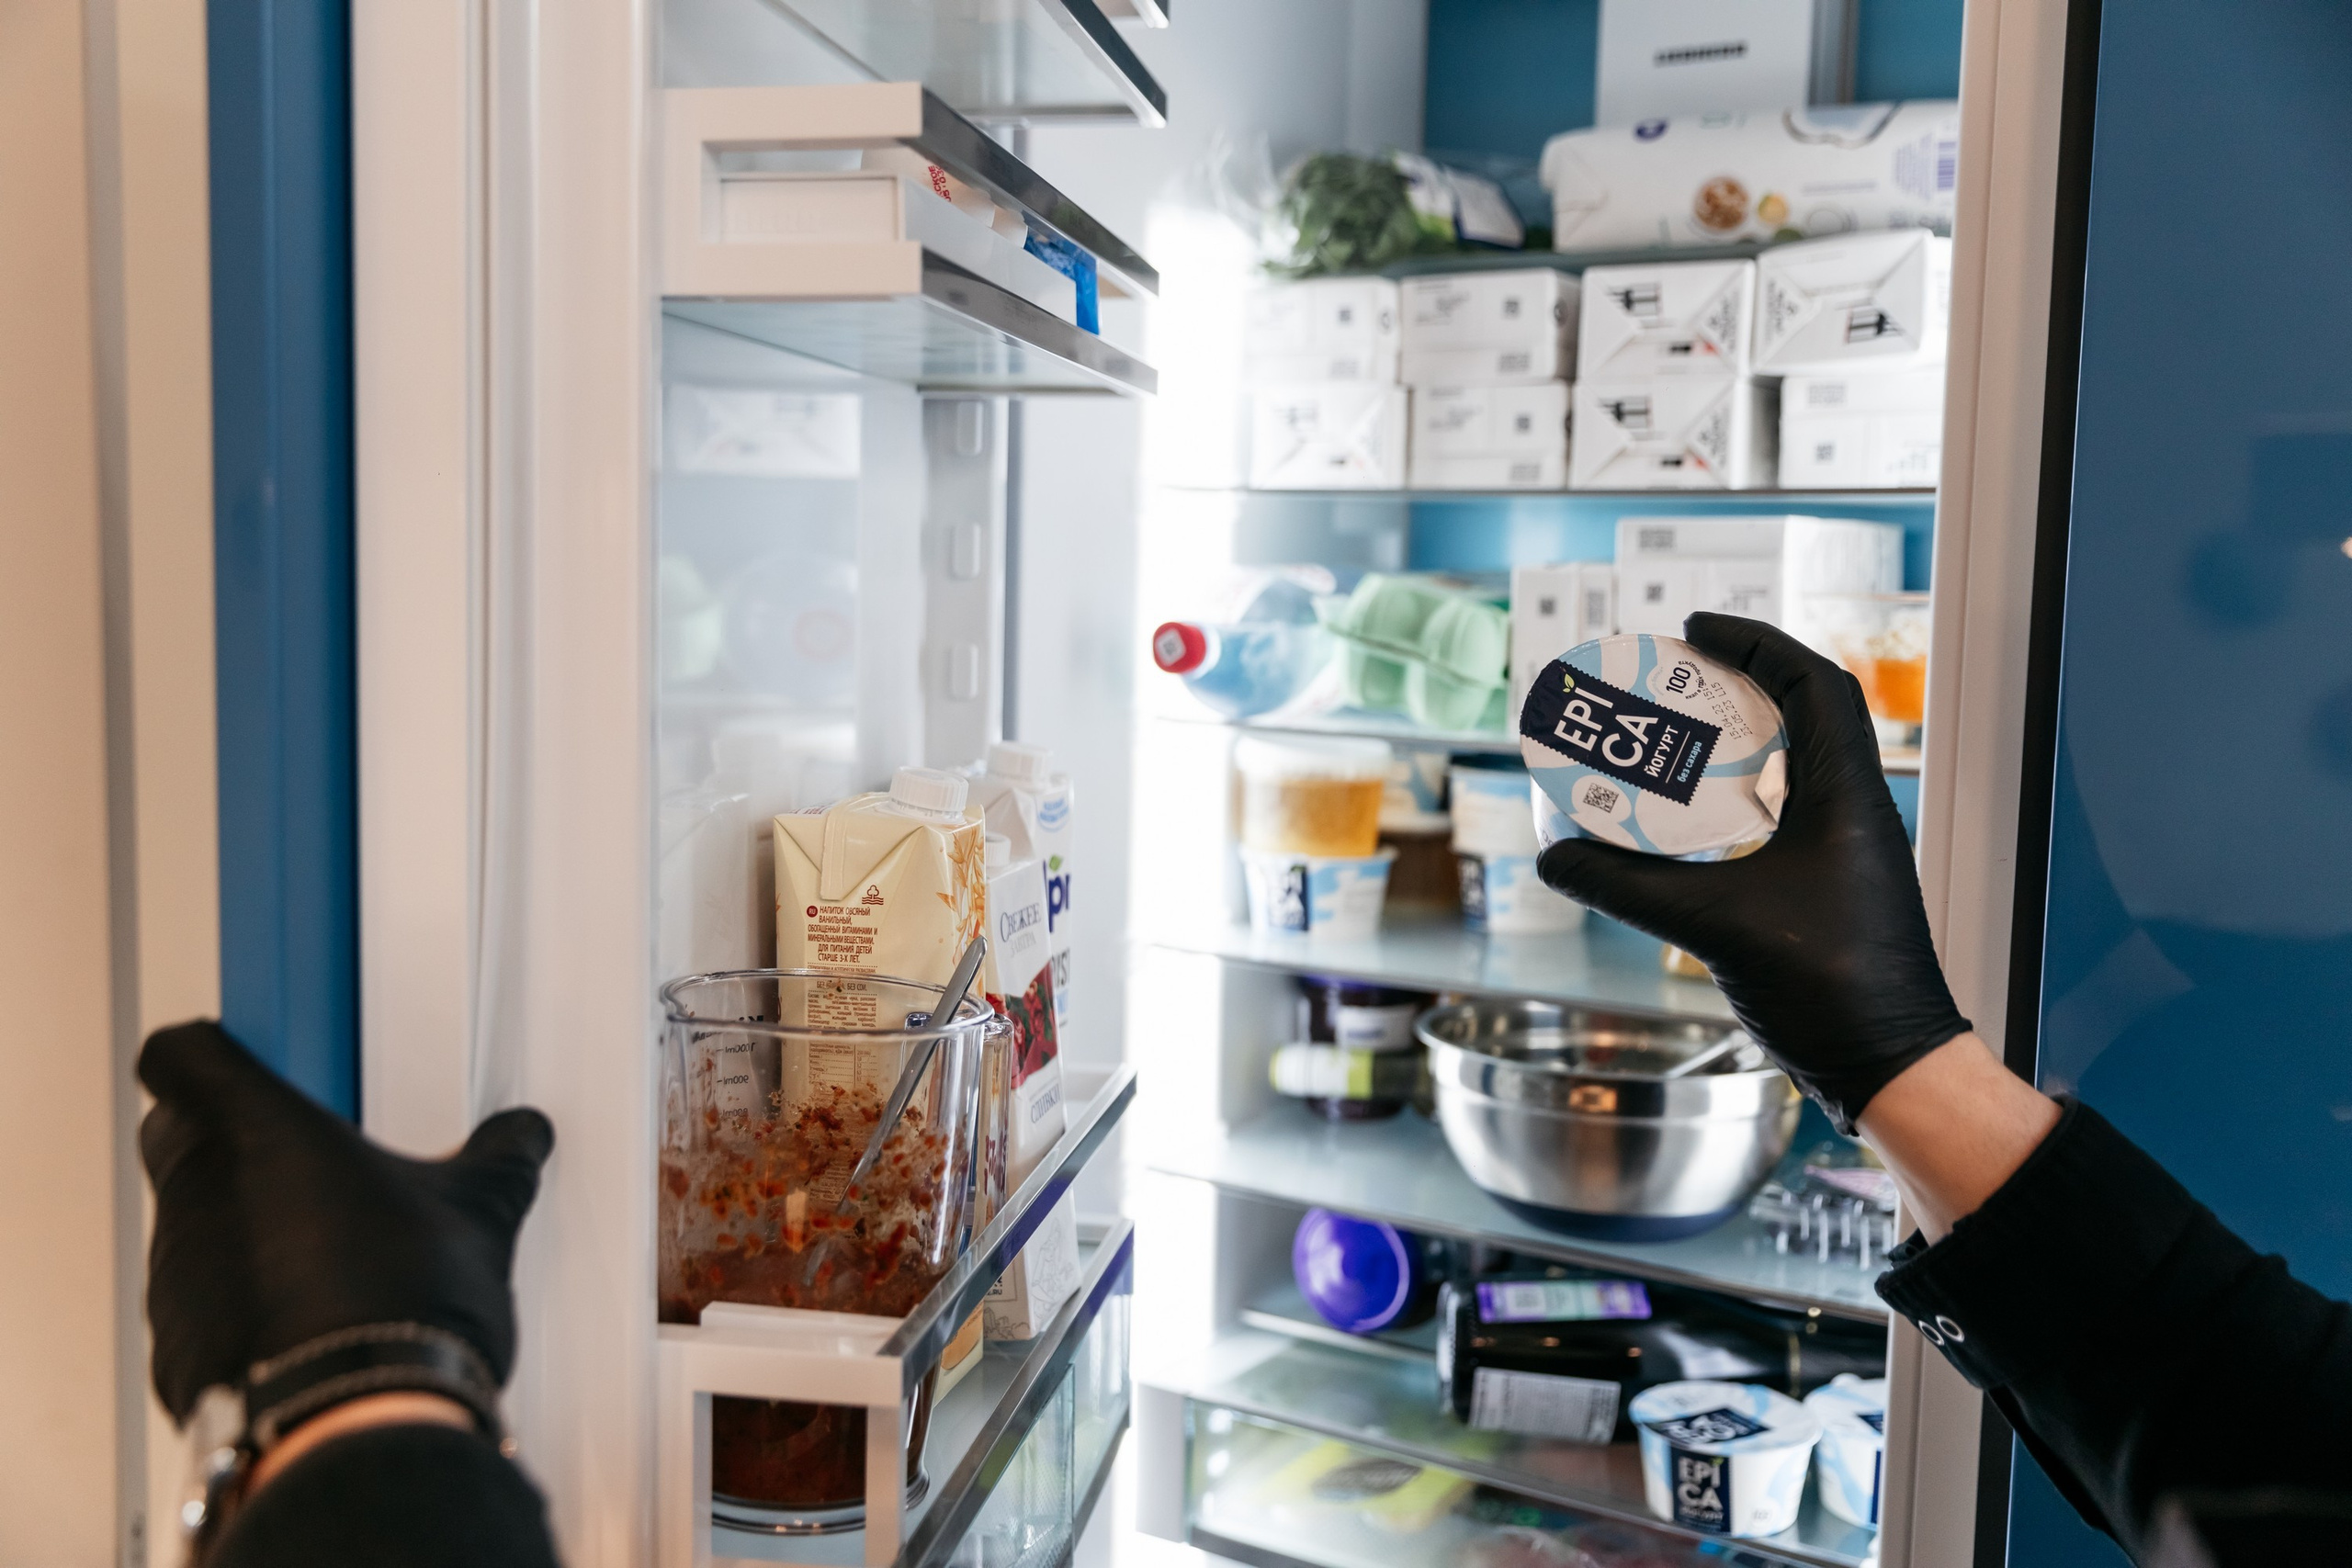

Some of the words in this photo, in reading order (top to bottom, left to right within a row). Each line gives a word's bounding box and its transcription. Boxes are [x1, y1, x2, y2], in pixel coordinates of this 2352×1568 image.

[1666, 667, 1690, 694] 100
[1711, 682, 1727, 697] L15
[1554, 687, 1613, 751] EPI
[1712, 704, 1742, 739] 15.04.23
[1723, 700, 1753, 737] 23.05.23
[1601, 715, 1658, 767] CA
[1644, 725, 1679, 778] ЙОГУРТ
[1677, 768, 1690, 783] без
[1685, 741, 1702, 768] сахара
[819, 915, 853, 926] ВАНИЛЬНЫЙ,
[820, 906, 844, 915] НАПИТОК
[845, 907, 871, 917] ОВСЯНЫЙ
[1001, 902, 1042, 942] СВЕЖЕЕ
[808, 923, 841, 934] ОБОГАЩЕННЫЙ
[842, 925, 873, 935] ВИТАМИНАМИ
[874, 927, 878, 936] И
[808, 933, 843, 943] МИНЕРАЛЬНЫМИ
[818, 943, 829, 953] ДЛЯ
[830, 944, 854, 953] ПИТАНИЯ
[855, 944, 873, 954] ДЕТЕЙ
[818, 953, 838, 962] СТАРШЕ
[849, 954, 860, 964] ЛЕТ.
[847, 982, 855, 991] БЕЗ
[1031, 1083, 1061, 1123] СЛИВКИ
[1678, 1457, 1721, 1488] EPI
[1678, 1483, 1724, 1511] CA
